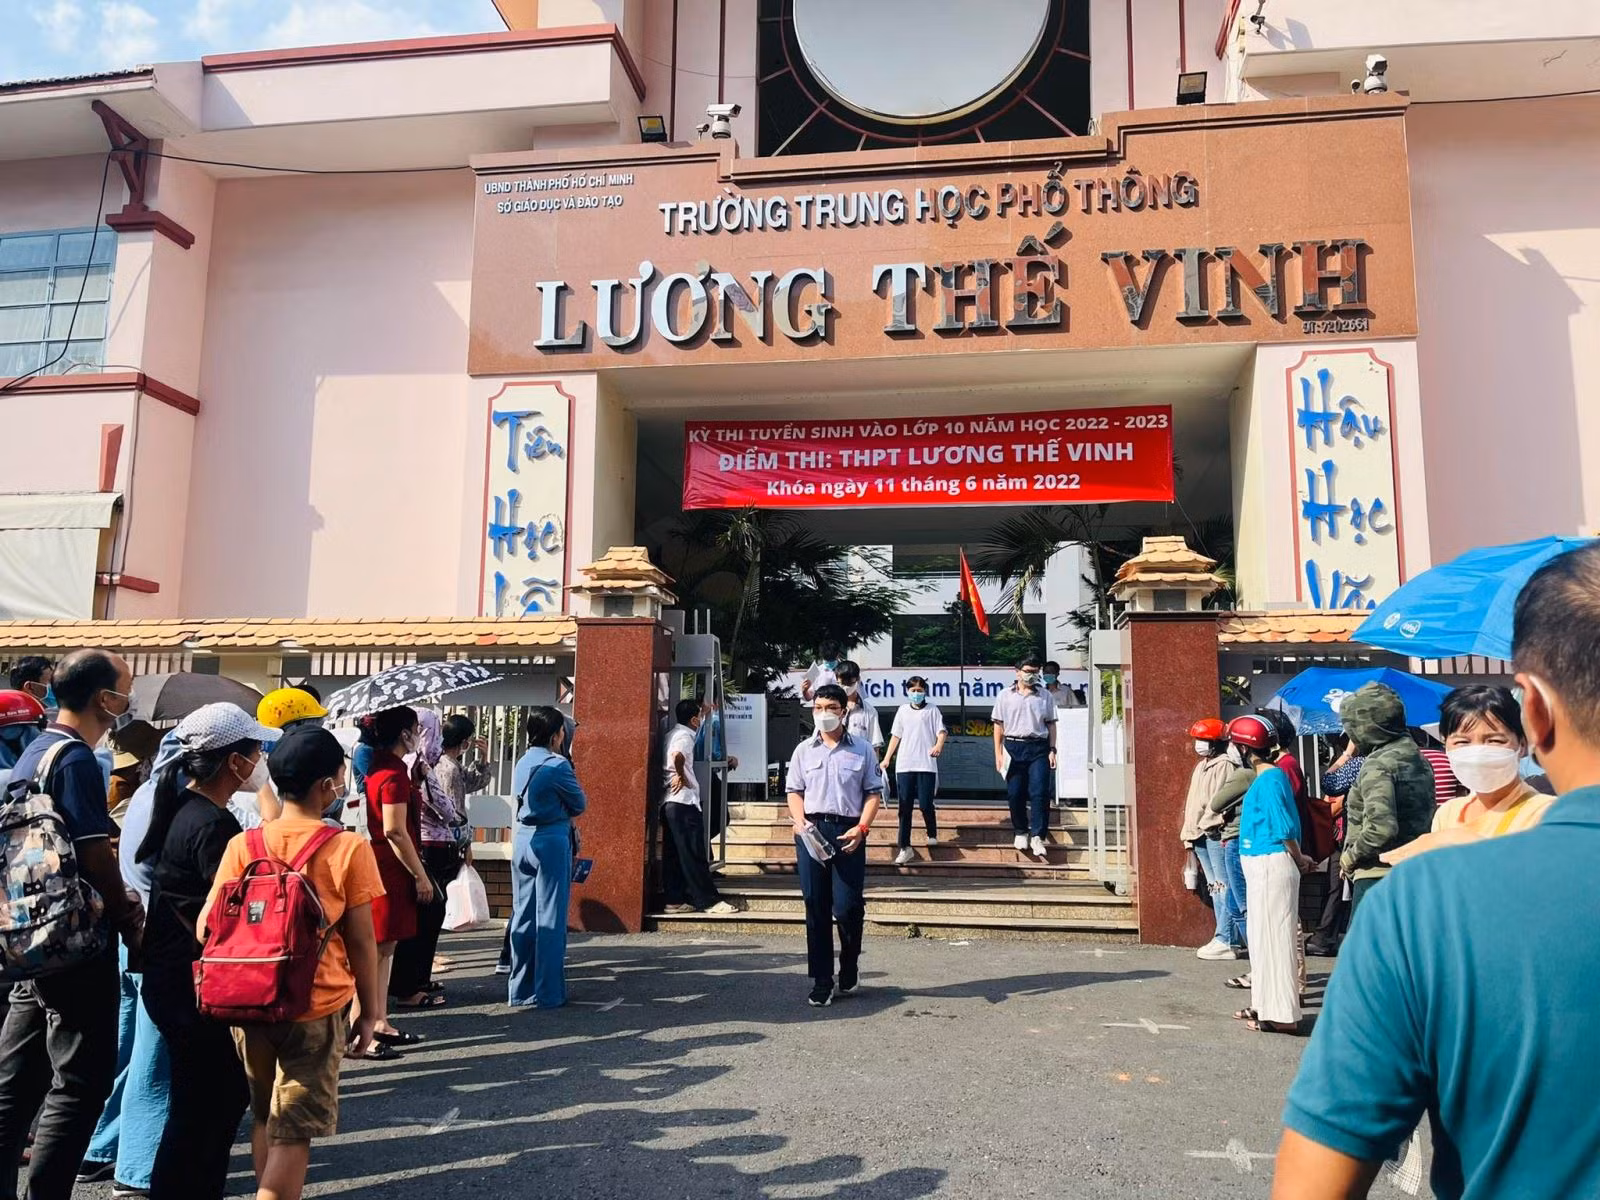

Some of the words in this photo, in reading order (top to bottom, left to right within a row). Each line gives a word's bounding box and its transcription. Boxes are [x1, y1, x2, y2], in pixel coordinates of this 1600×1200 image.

[484, 181, 511, 194] UBND
[514, 177, 548, 192] THÀNH
[549, 173, 570, 189] PHỐ
[588, 173, 606, 187] CHÍ
[608, 173, 634, 186] MINH
[659, 187, 788, 233] TRƯỜNG
[794, 189, 905, 226] TRUNG
[916, 184, 988, 227] HỌC
[997, 161, 1066, 217] PHỔ
[1075, 166, 1198, 213] THÔNG
[514, 197, 541, 212] GIÁO
[540, 198, 561, 213] DỤC
[563, 195, 576, 209] VÀ
[578, 195, 599, 208] ĐÀO
[602, 194, 623, 209] TẠO
[533, 260, 832, 348] LƯƠNG
[872, 222, 1066, 334] THẾ
[1101, 239, 1371, 326] VINH
[689, 429, 710, 443] KỲ
[716, 429, 743, 441] THI
[750, 422, 805, 440] TUYỂN
[811, 426, 853, 438] SINH
[859, 421, 897, 437] VÀO
[903, 420, 939, 436] LỚP
[945, 422, 964, 434] 10
[970, 417, 1014, 433] NĂM
[1021, 418, 1060, 434] HỌC
[1065, 417, 1108, 430] 2022
[1125, 414, 1168, 428] 2023
[719, 446, 777, 471] ĐIỂM
[785, 451, 832, 469] THI:
[839, 448, 901, 468] THPT
[909, 445, 1003, 465] LƯƠNG
[1011, 438, 1061, 462] THẾ
[1066, 442, 1133, 461] VINH
[767, 479, 815, 496] Khóa
[821, 478, 868, 498] ngày
[874, 478, 895, 492] 11
[901, 476, 960, 496] tháng
[965, 476, 976, 490] 6
[982, 474, 1027, 490] năm
[1033, 474, 1080, 490] 2022
[1302, 459, 1393, 546] Học
[959, 677, 1004, 697] năm
